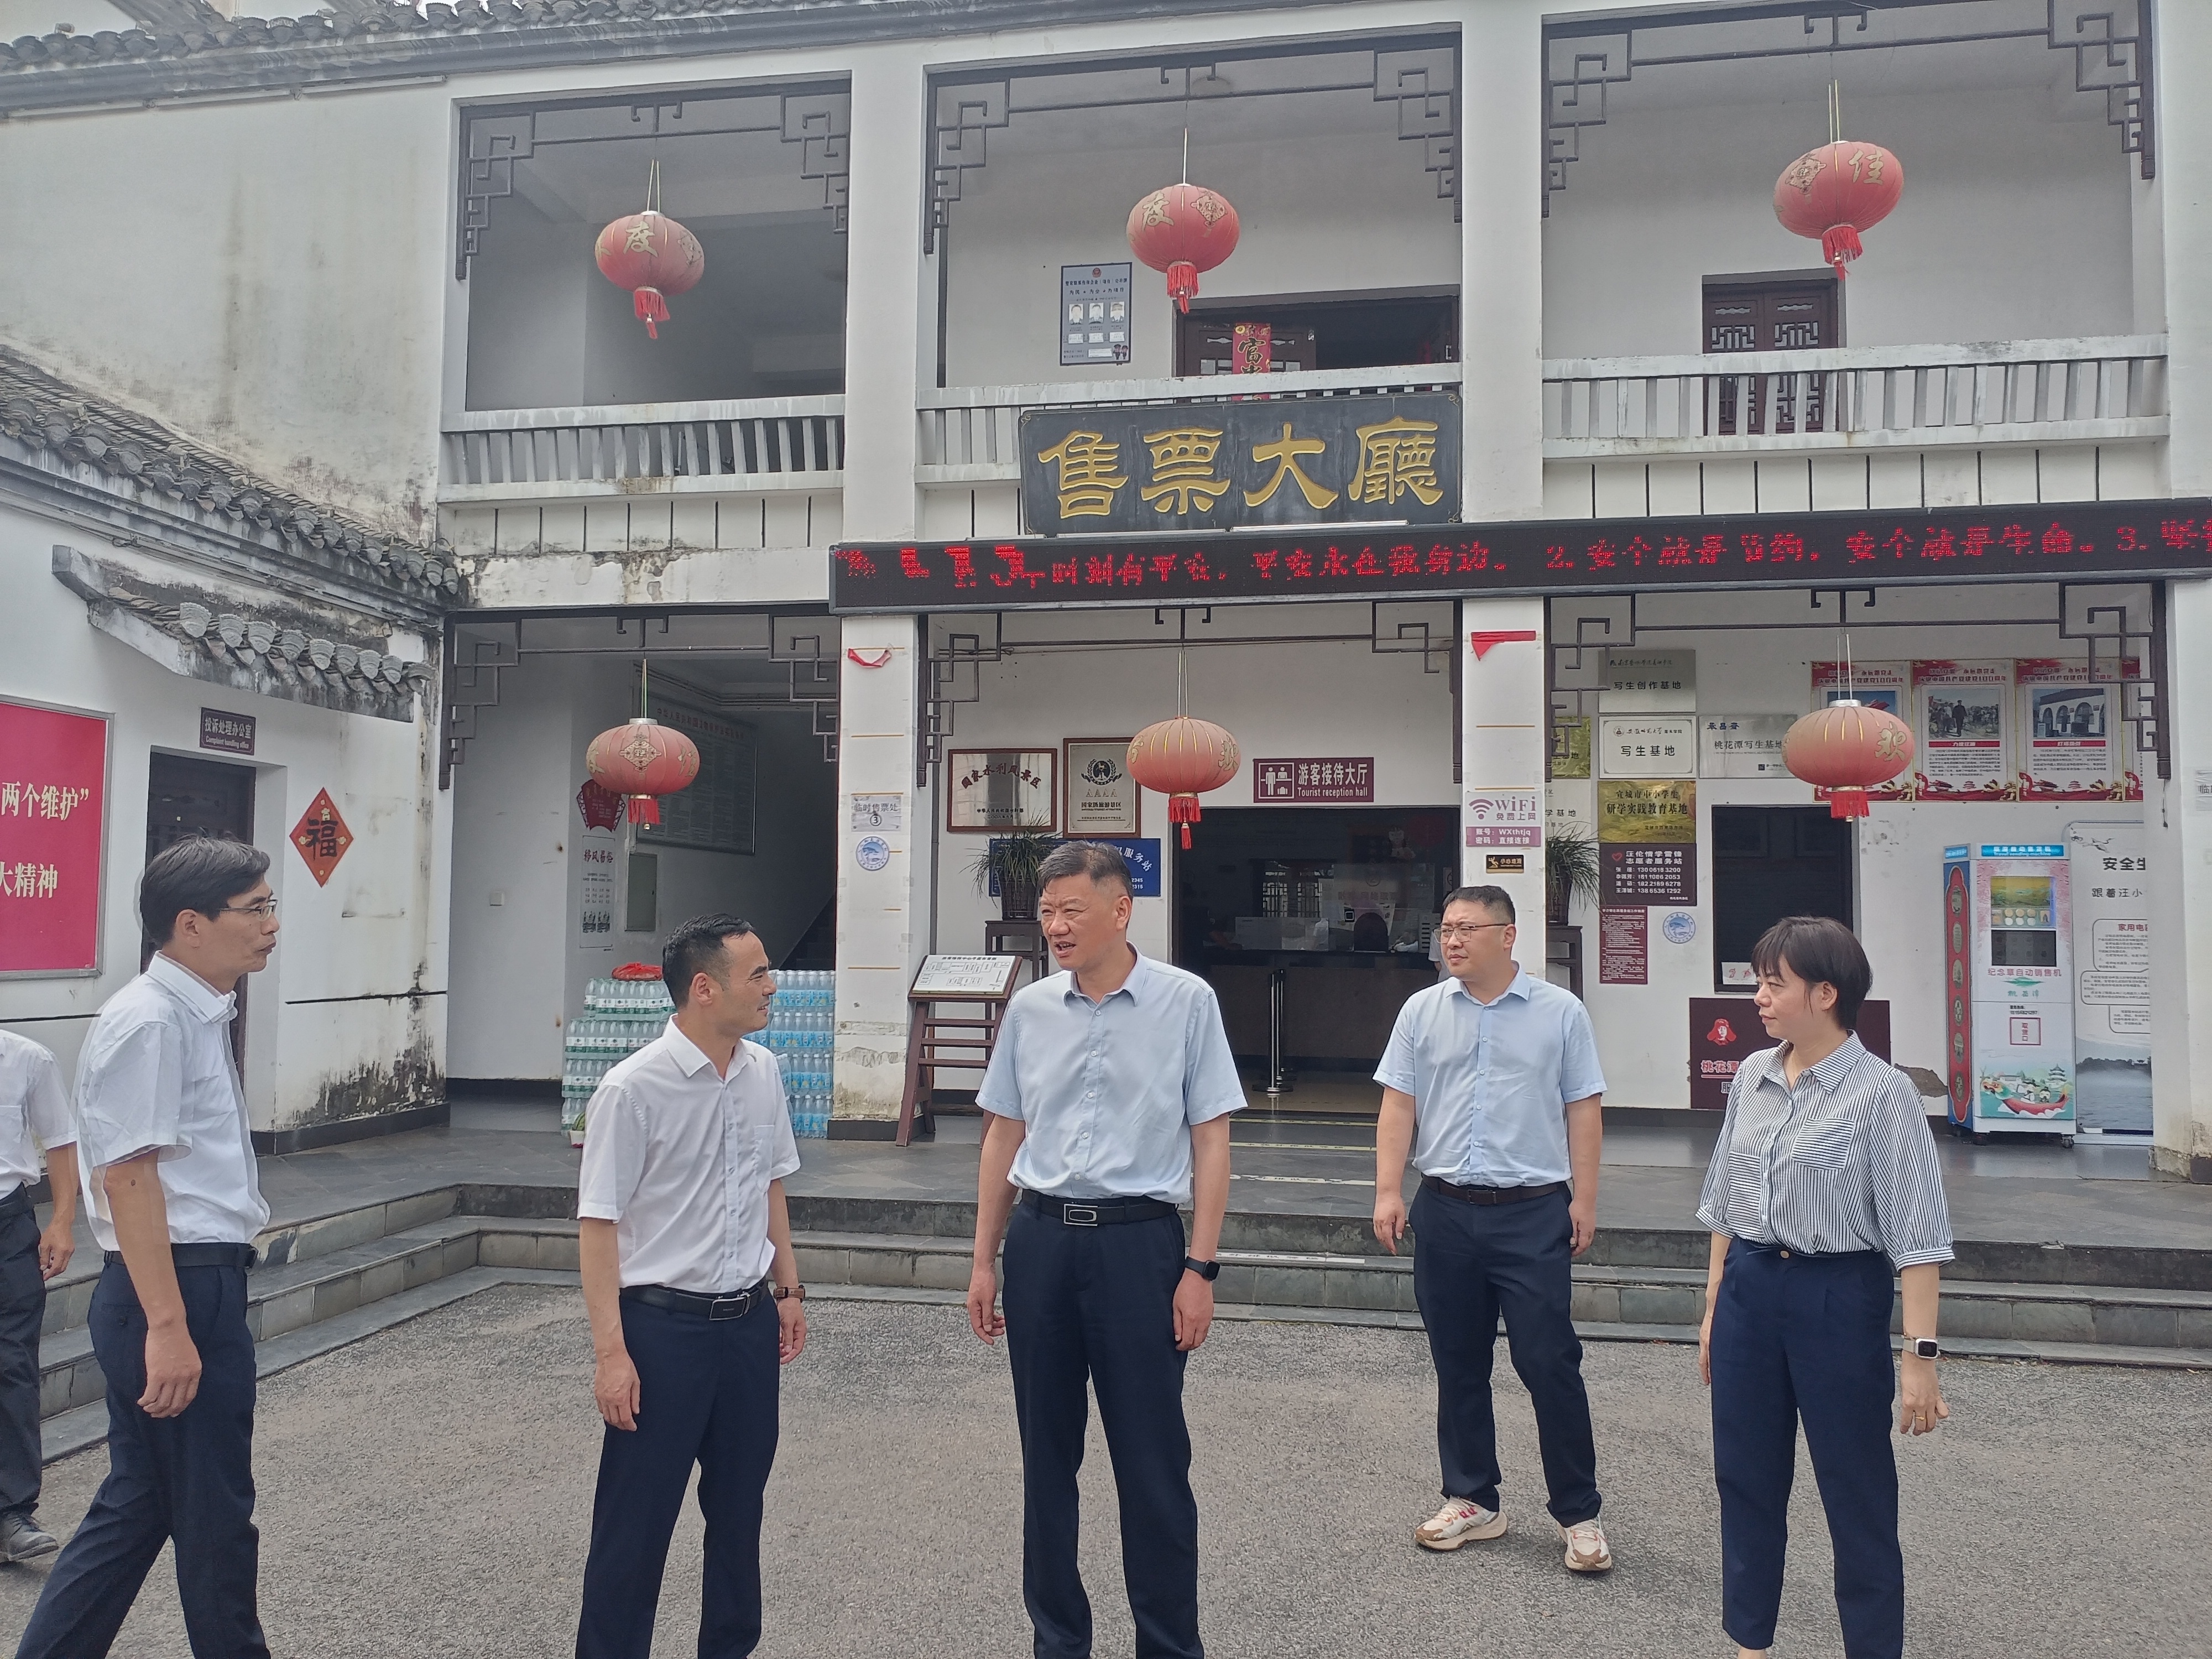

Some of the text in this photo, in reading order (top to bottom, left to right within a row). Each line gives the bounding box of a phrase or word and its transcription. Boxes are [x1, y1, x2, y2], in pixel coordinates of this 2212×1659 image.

[1037, 415, 1444, 520] 售票大廳
[1614, 681, 1682, 690] 写生创作基地
[205, 716, 252, 739] 投诉处理办公室
[1620, 744, 1676, 757] 写生基地
[961, 763, 1042, 789] 国家水利风景区
[1297, 761, 1368, 786] 游客接待大厅
[1086, 788, 1118, 797] AAAA
[1322, 787, 1354, 799] reception
[1355, 786, 1368, 797] hall
[1616, 790, 1679, 799] 宣城市中小学生
[2198, 784, 2212, 794] 临
[854, 802, 899, 812] 临时售票处
[1494, 796, 1536, 812] WiFi
[1606, 802, 1688, 815] 研学实践教育基地
[1496, 812, 1536, 821] 免费上网
[305, 817, 339, 862] 福
[583, 849, 613, 863] 移风易俗
[1987, 968, 2062, 977] 纪念章自动销售机
